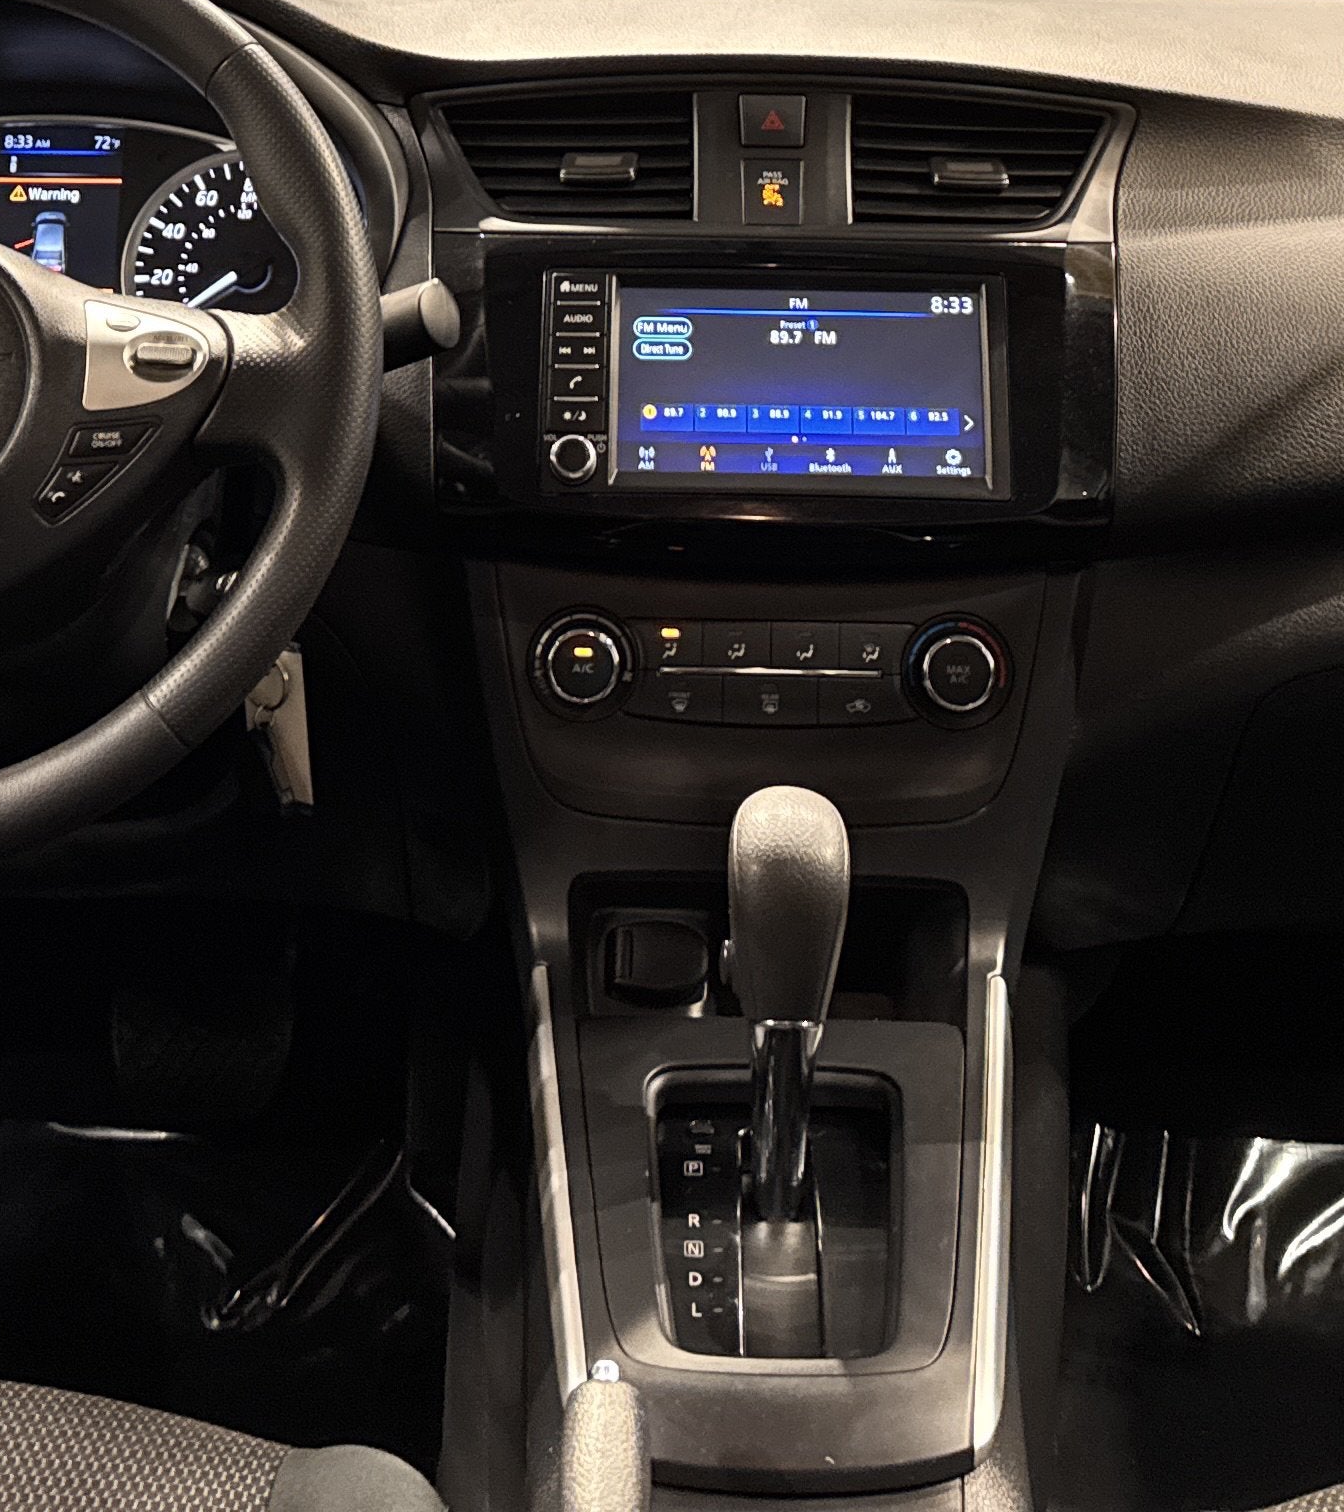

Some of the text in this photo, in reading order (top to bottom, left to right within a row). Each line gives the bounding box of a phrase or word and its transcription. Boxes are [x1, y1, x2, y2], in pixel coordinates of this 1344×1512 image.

[3, 134, 34, 149] 8:33
[35, 139, 51, 149] AM
[28, 187, 81, 204] Warning
[195, 190, 219, 207] 60
[162, 222, 186, 240] 40
[150, 269, 174, 286] 20
[570, 284, 598, 293] MENU
[788, 297, 809, 310] FM
[930, 296, 974, 315] 8:33
[563, 314, 594, 323] AUDIO
[779, 319, 806, 329] Preset
[637, 323, 688, 334] FM Menu
[769, 330, 837, 345] 89.7 FM
[640, 344, 684, 355] Direct Tune
[638, 461, 655, 471] AM
[700, 461, 715, 471] FM
[760, 462, 778, 472] USB
[808, 462, 852, 474] Bluetooth
[882, 464, 903, 474] AUX
[936, 465, 972, 478] Settings
[571, 663, 595, 674] A/C
[688, 1163, 699, 1174] P
[688, 1213, 701, 1228] R
[687, 1242, 701, 1256] N
[688, 1272, 703, 1286] D
[691, 1302, 703, 1318] L
